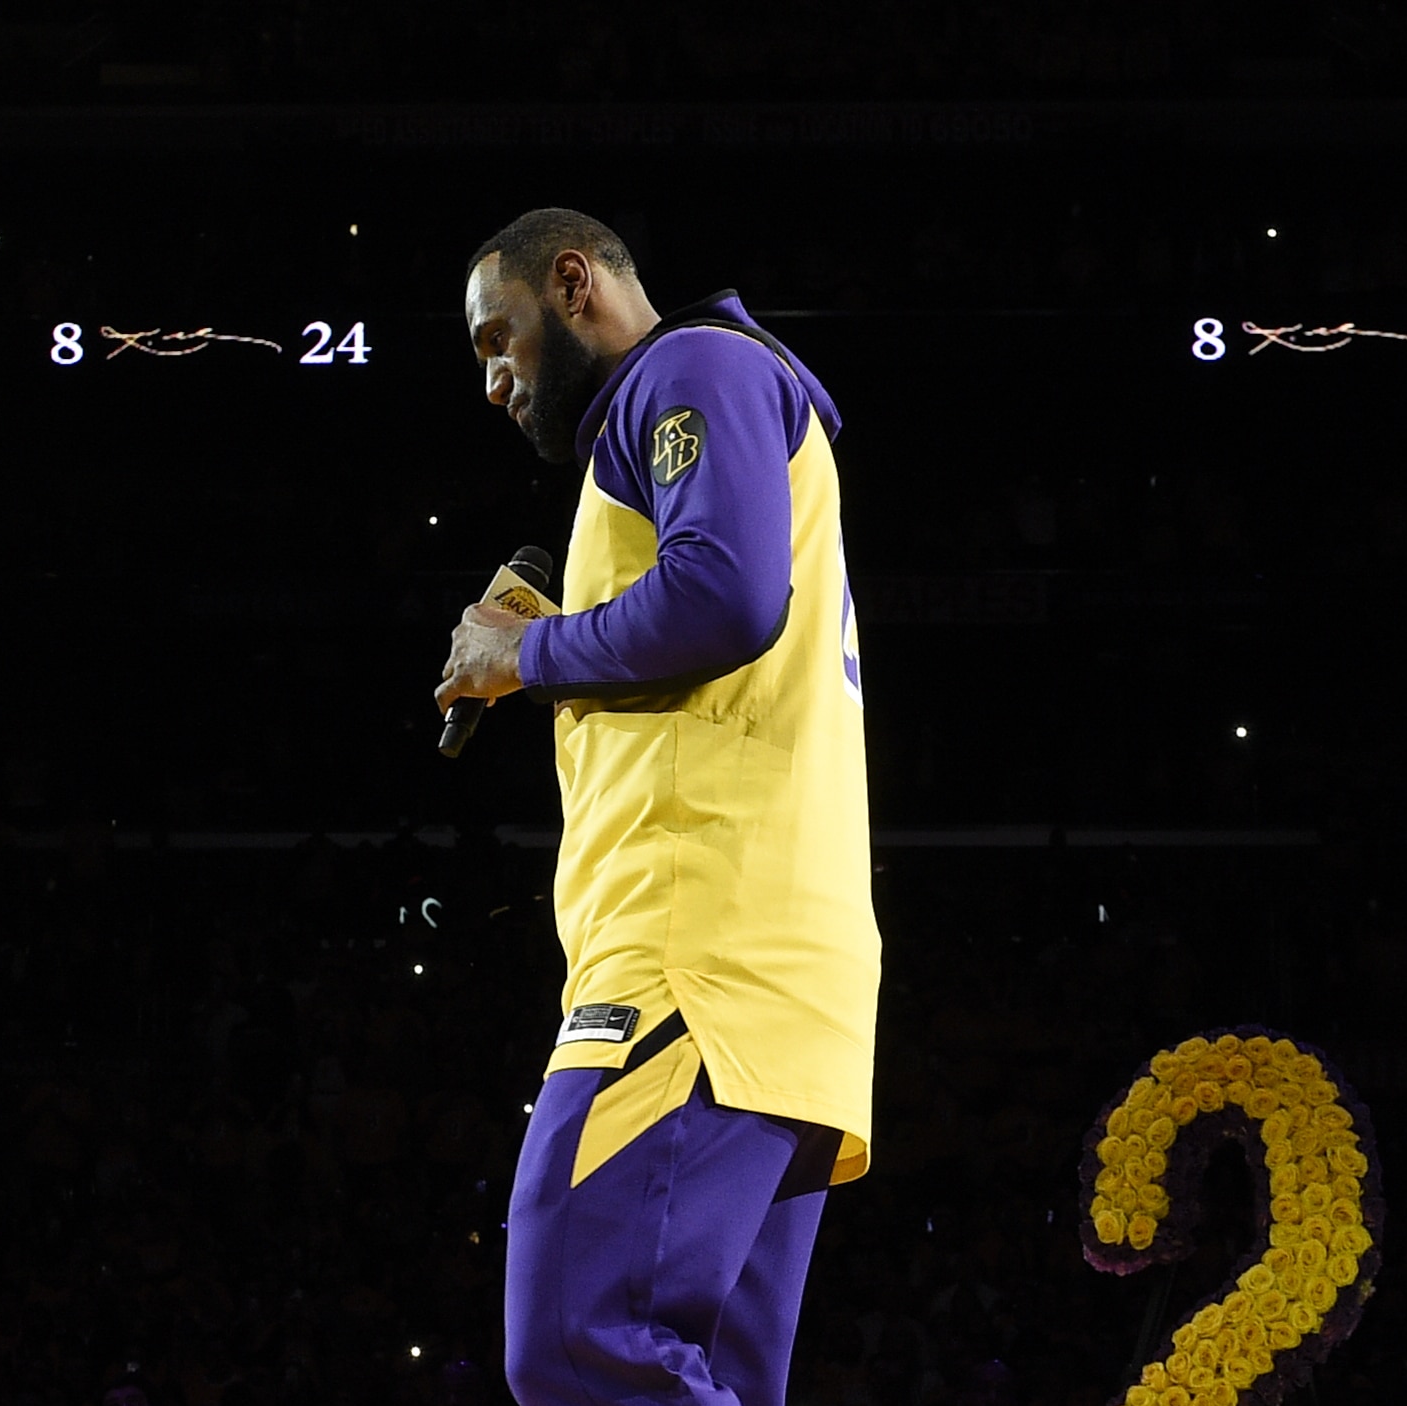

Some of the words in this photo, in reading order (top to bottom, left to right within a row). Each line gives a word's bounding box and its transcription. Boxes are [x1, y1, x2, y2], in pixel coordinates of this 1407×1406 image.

[50, 322, 84, 365] 8
[299, 321, 373, 365] 24
[1191, 317, 1226, 361] 8
